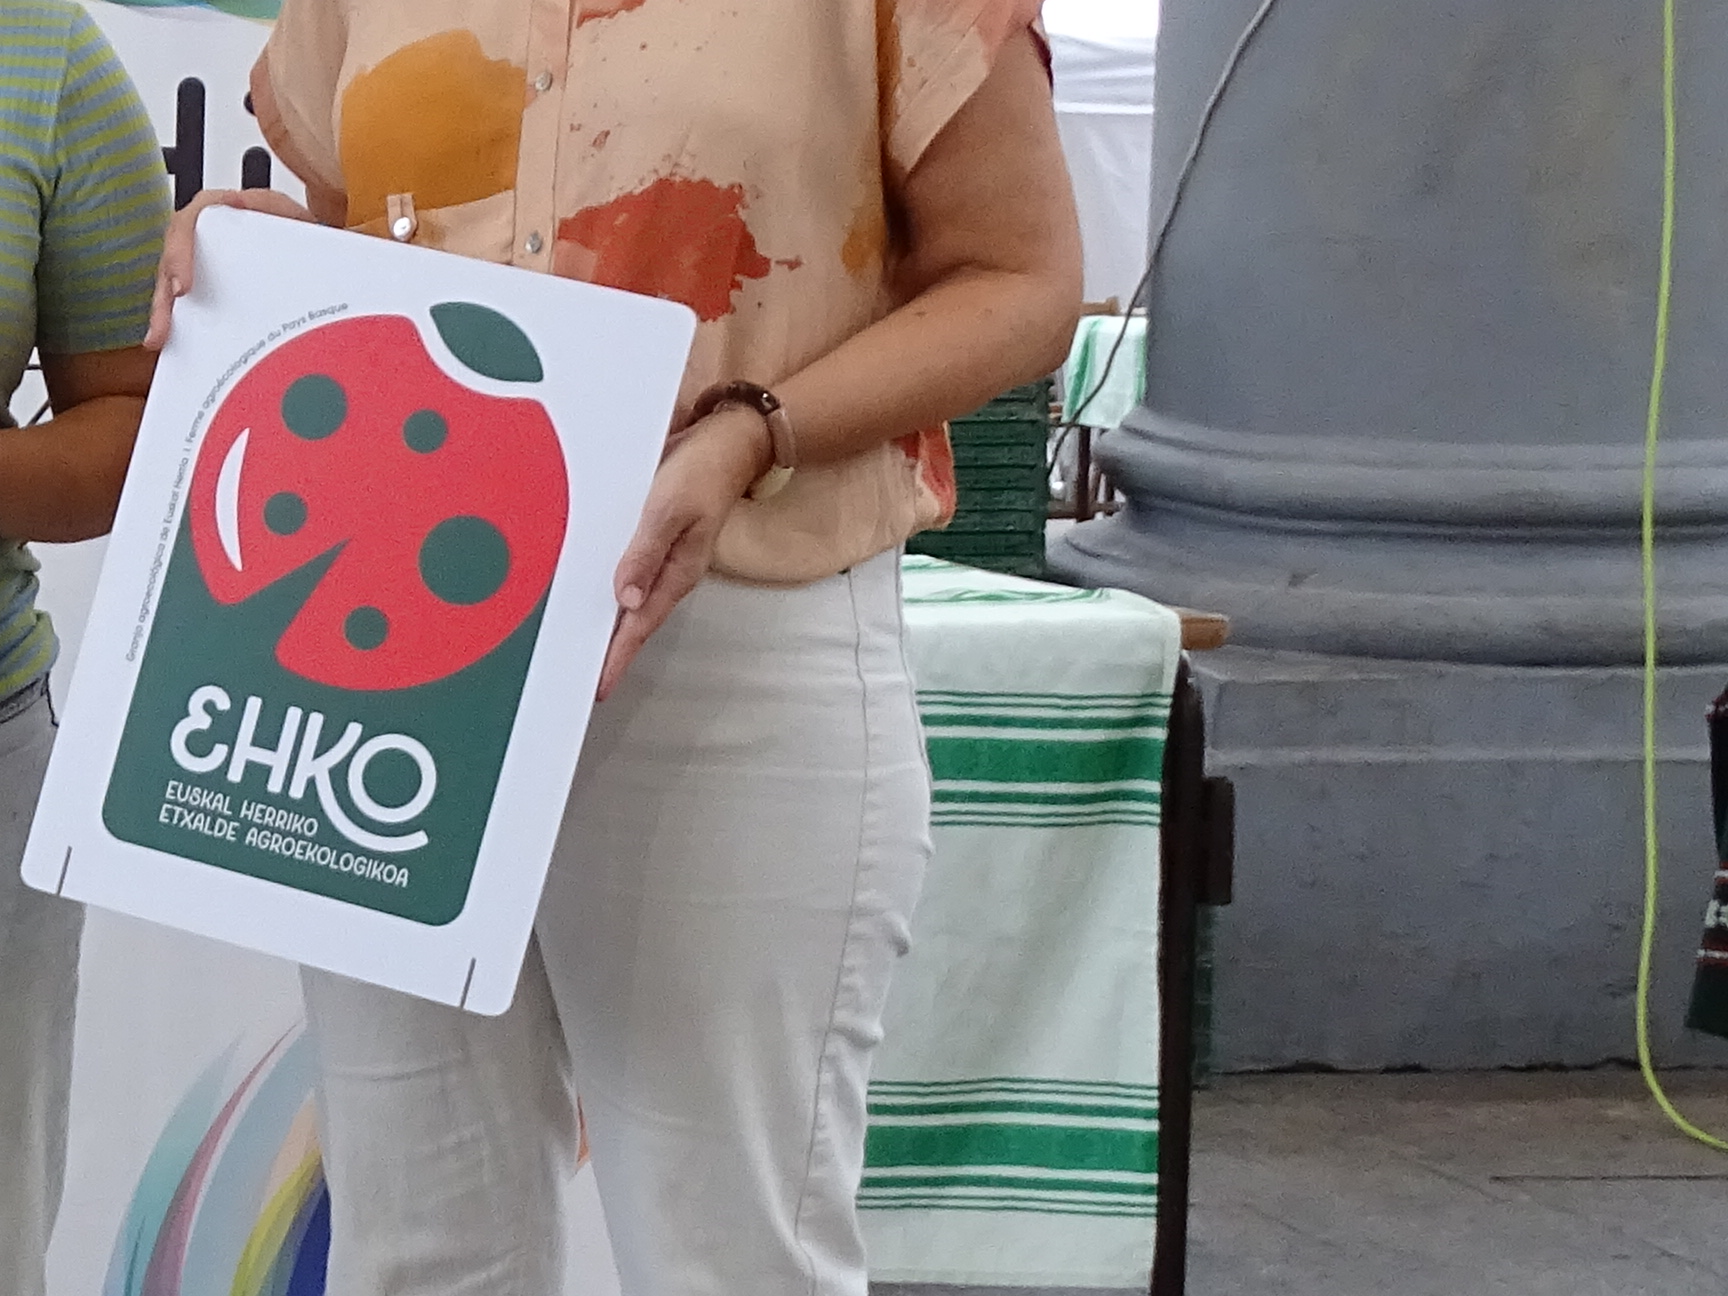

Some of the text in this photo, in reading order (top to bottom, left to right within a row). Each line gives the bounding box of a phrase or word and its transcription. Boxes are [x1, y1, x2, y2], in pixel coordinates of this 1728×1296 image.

[160, 524, 170, 541] de
[185, 409, 205, 444] Ferme
[267, 329, 282, 343] du
[281, 316, 307, 334] Pays
[307, 302, 349, 321] Basque
[165, 780, 319, 837] EUSKAL HERRIKO
[170, 684, 437, 853] EHKO
[158, 803, 410, 889] ETXALDE AGROEKOLOGIKOA
